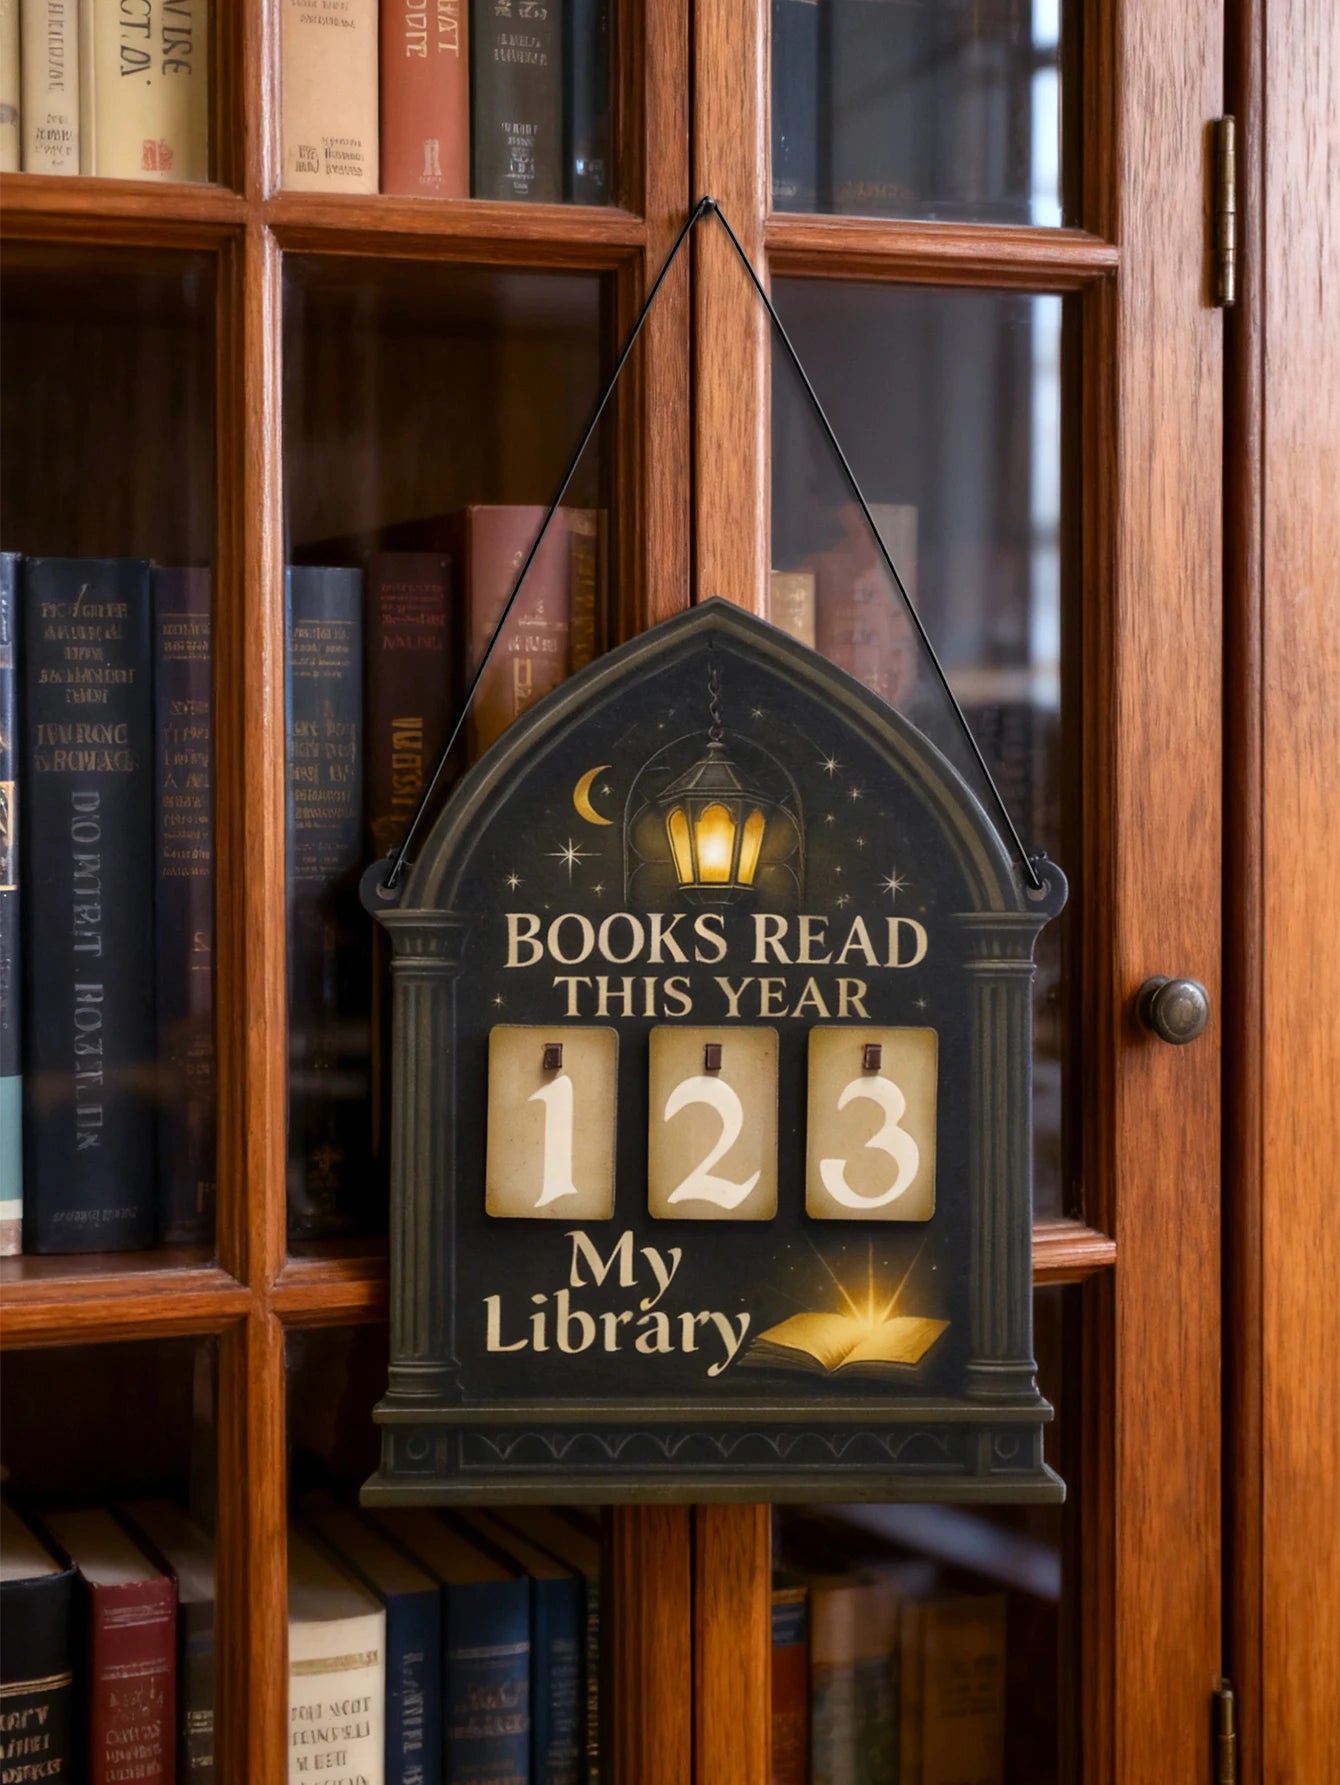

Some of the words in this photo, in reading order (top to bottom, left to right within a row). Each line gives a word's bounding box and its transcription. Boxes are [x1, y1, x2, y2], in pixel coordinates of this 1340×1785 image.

[504, 912, 728, 968] BOOKS
[751, 913, 929, 968] READ
[553, 976, 693, 1017] THIS
[714, 976, 871, 1018] YEAR
[527, 1074, 579, 1208] 1
[664, 1075, 761, 1210] 2
[819, 1076, 920, 1209] 3
[564, 1230, 682, 1308] My
[482, 1289, 751, 1377] Library
